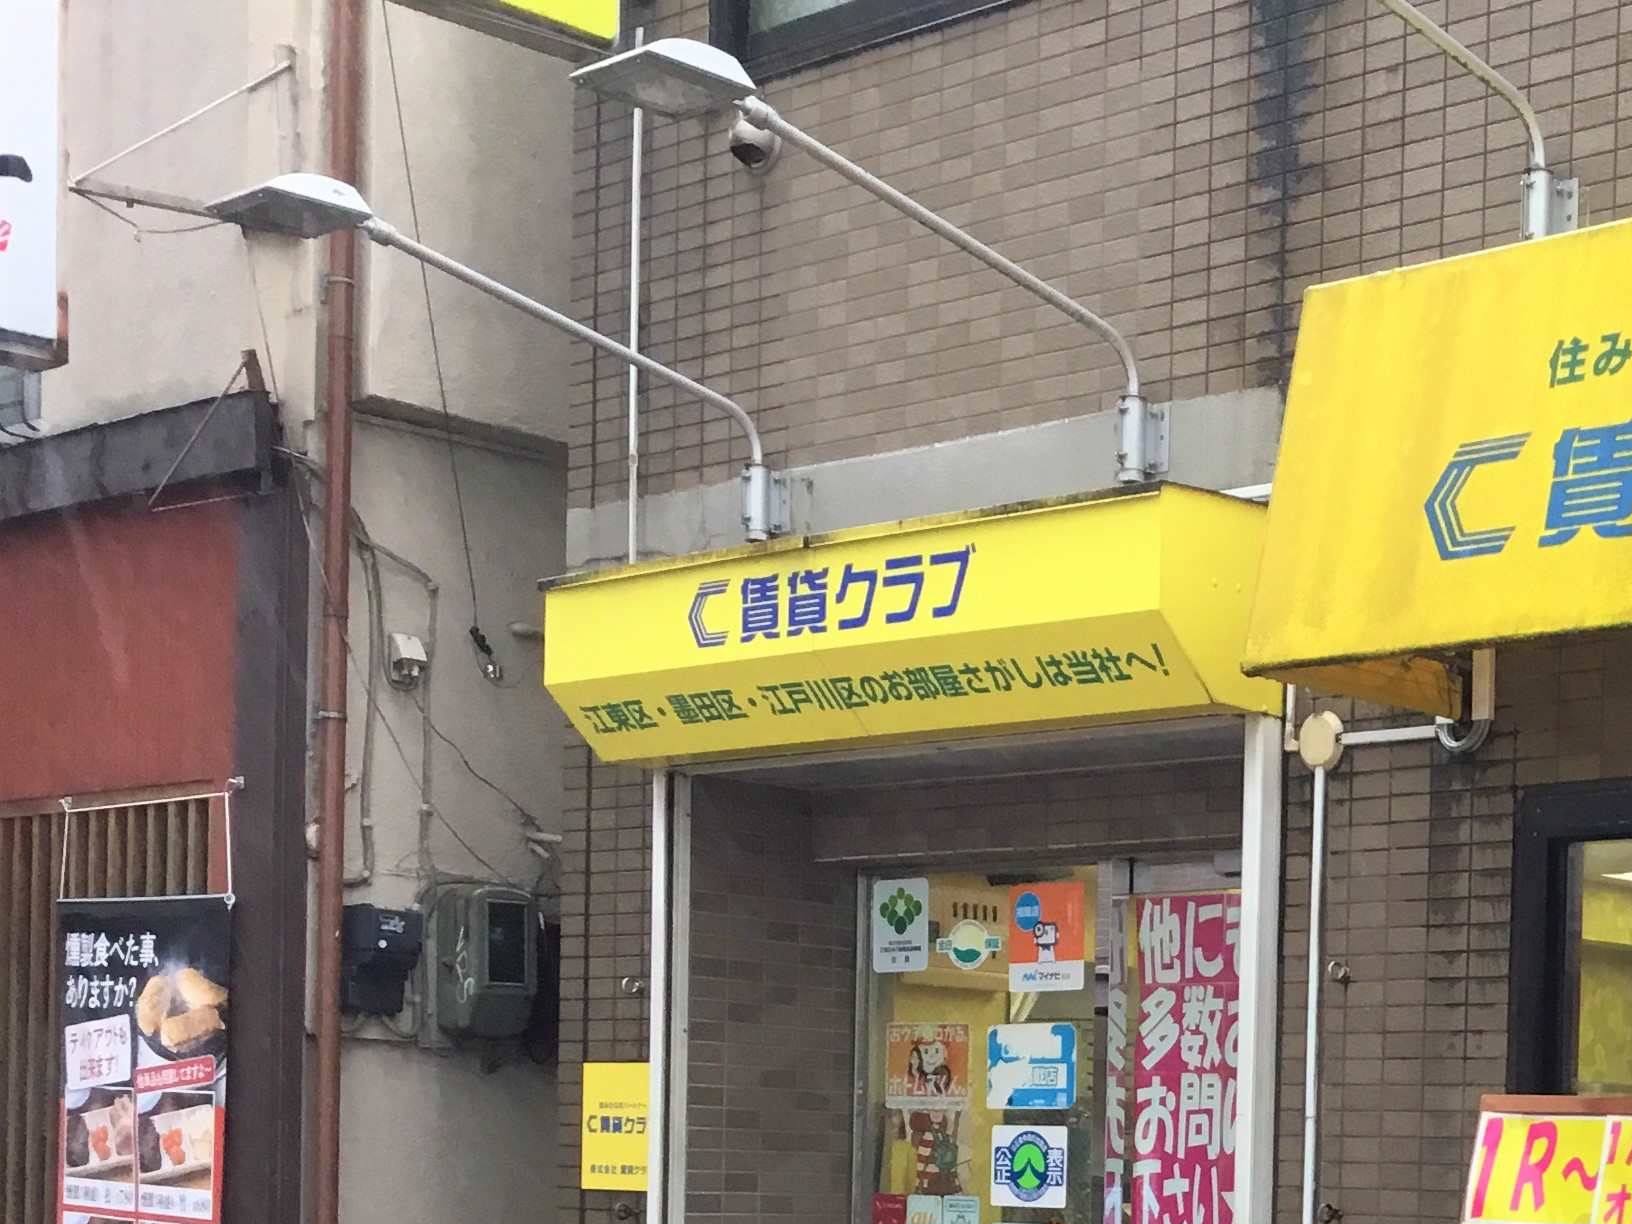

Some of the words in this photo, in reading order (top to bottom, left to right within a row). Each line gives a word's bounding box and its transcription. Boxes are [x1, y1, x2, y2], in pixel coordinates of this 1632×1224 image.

[600, 1115, 647, 1134] 賃貸クラ
[995, 1147, 1012, 1185] 公正
[1047, 1148, 1064, 1186] 表示
